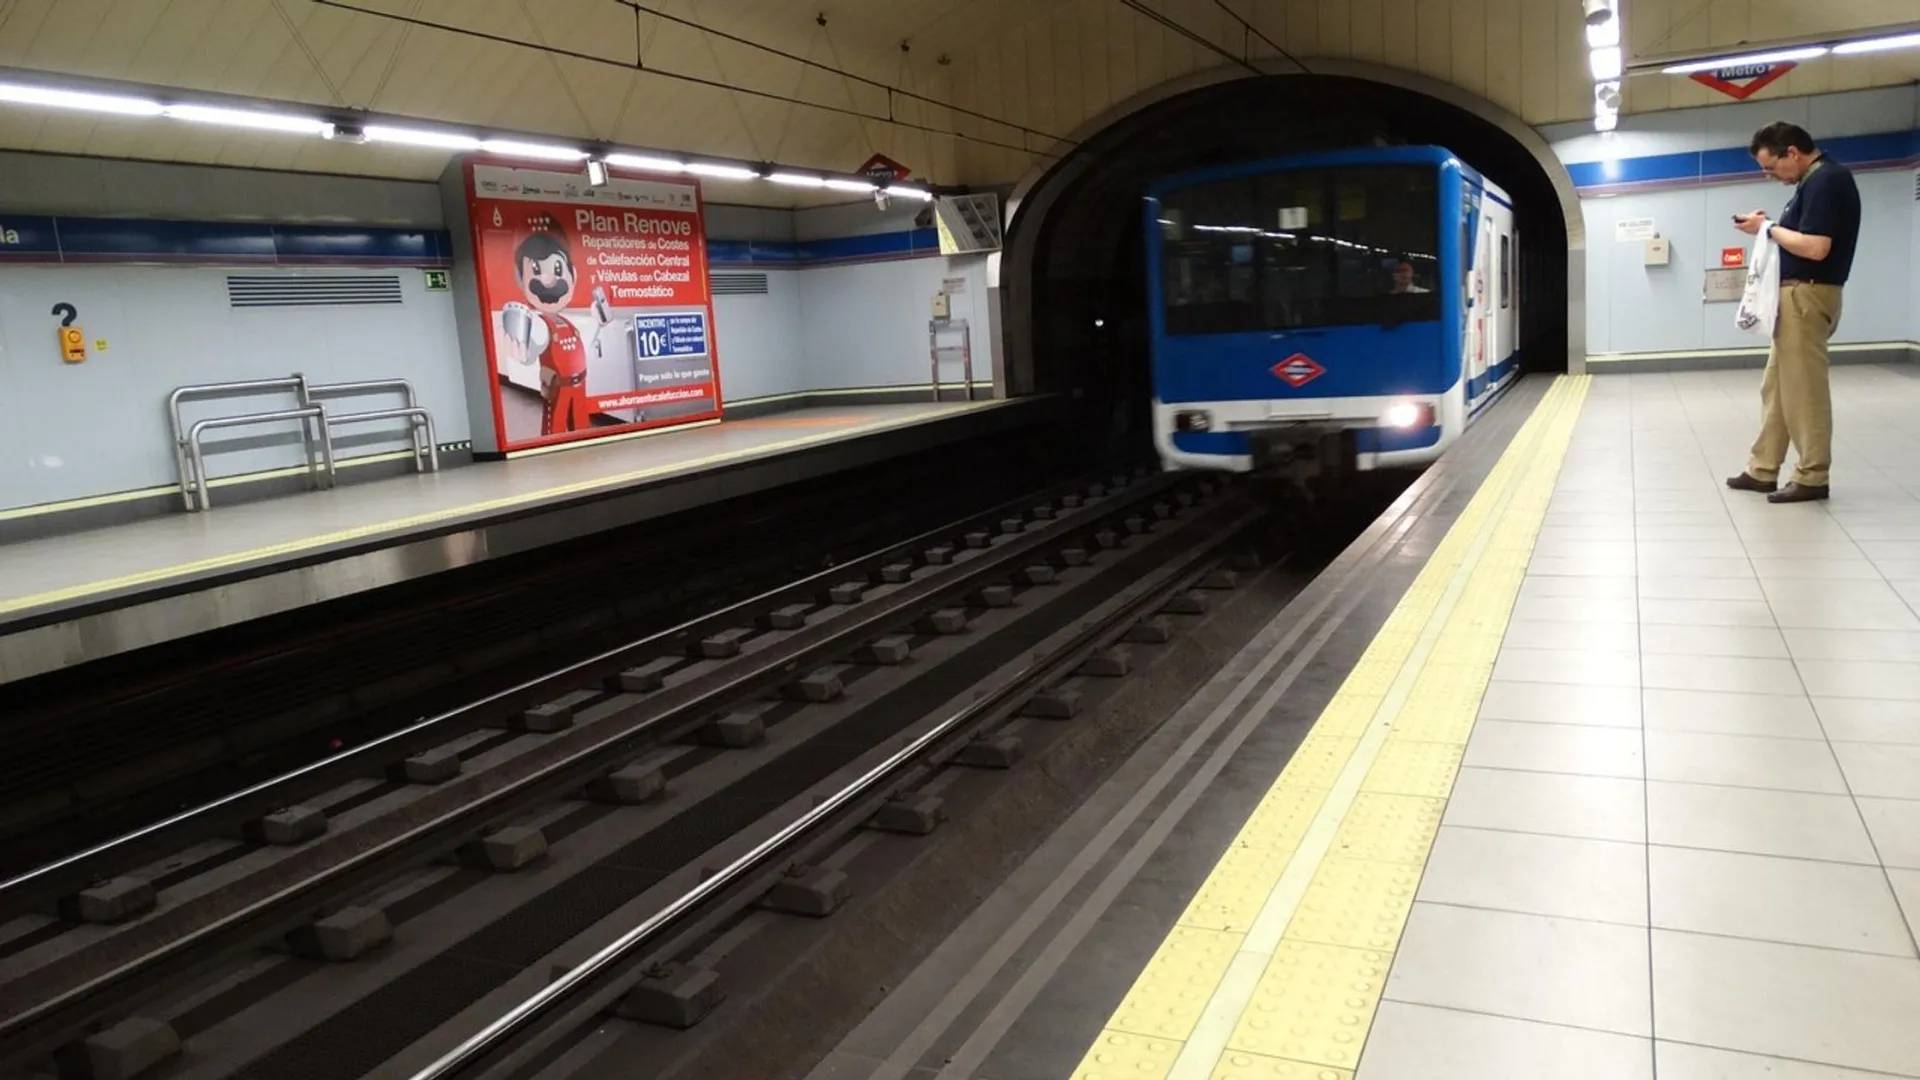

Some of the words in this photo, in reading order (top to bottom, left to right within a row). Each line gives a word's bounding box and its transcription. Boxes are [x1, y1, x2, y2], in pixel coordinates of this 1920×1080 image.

[1721, 64, 1765, 78] Metro
[575, 209, 620, 232] Plan
[623, 212, 692, 237] Renove
[582, 234, 646, 250] Repartidores
[647, 240, 657, 250] de
[657, 237, 690, 251] Costes
[586, 255, 597, 266] de
[598, 252, 656, 267] Calefacción
[657, 253, 690, 267] Central
[590, 274, 597, 284] y
[596, 268, 638, 282] Válvulas
[639, 273, 653, 282] con
[653, 269, 690, 282] Cabezal
[610, 284, 674, 298] Termostático
